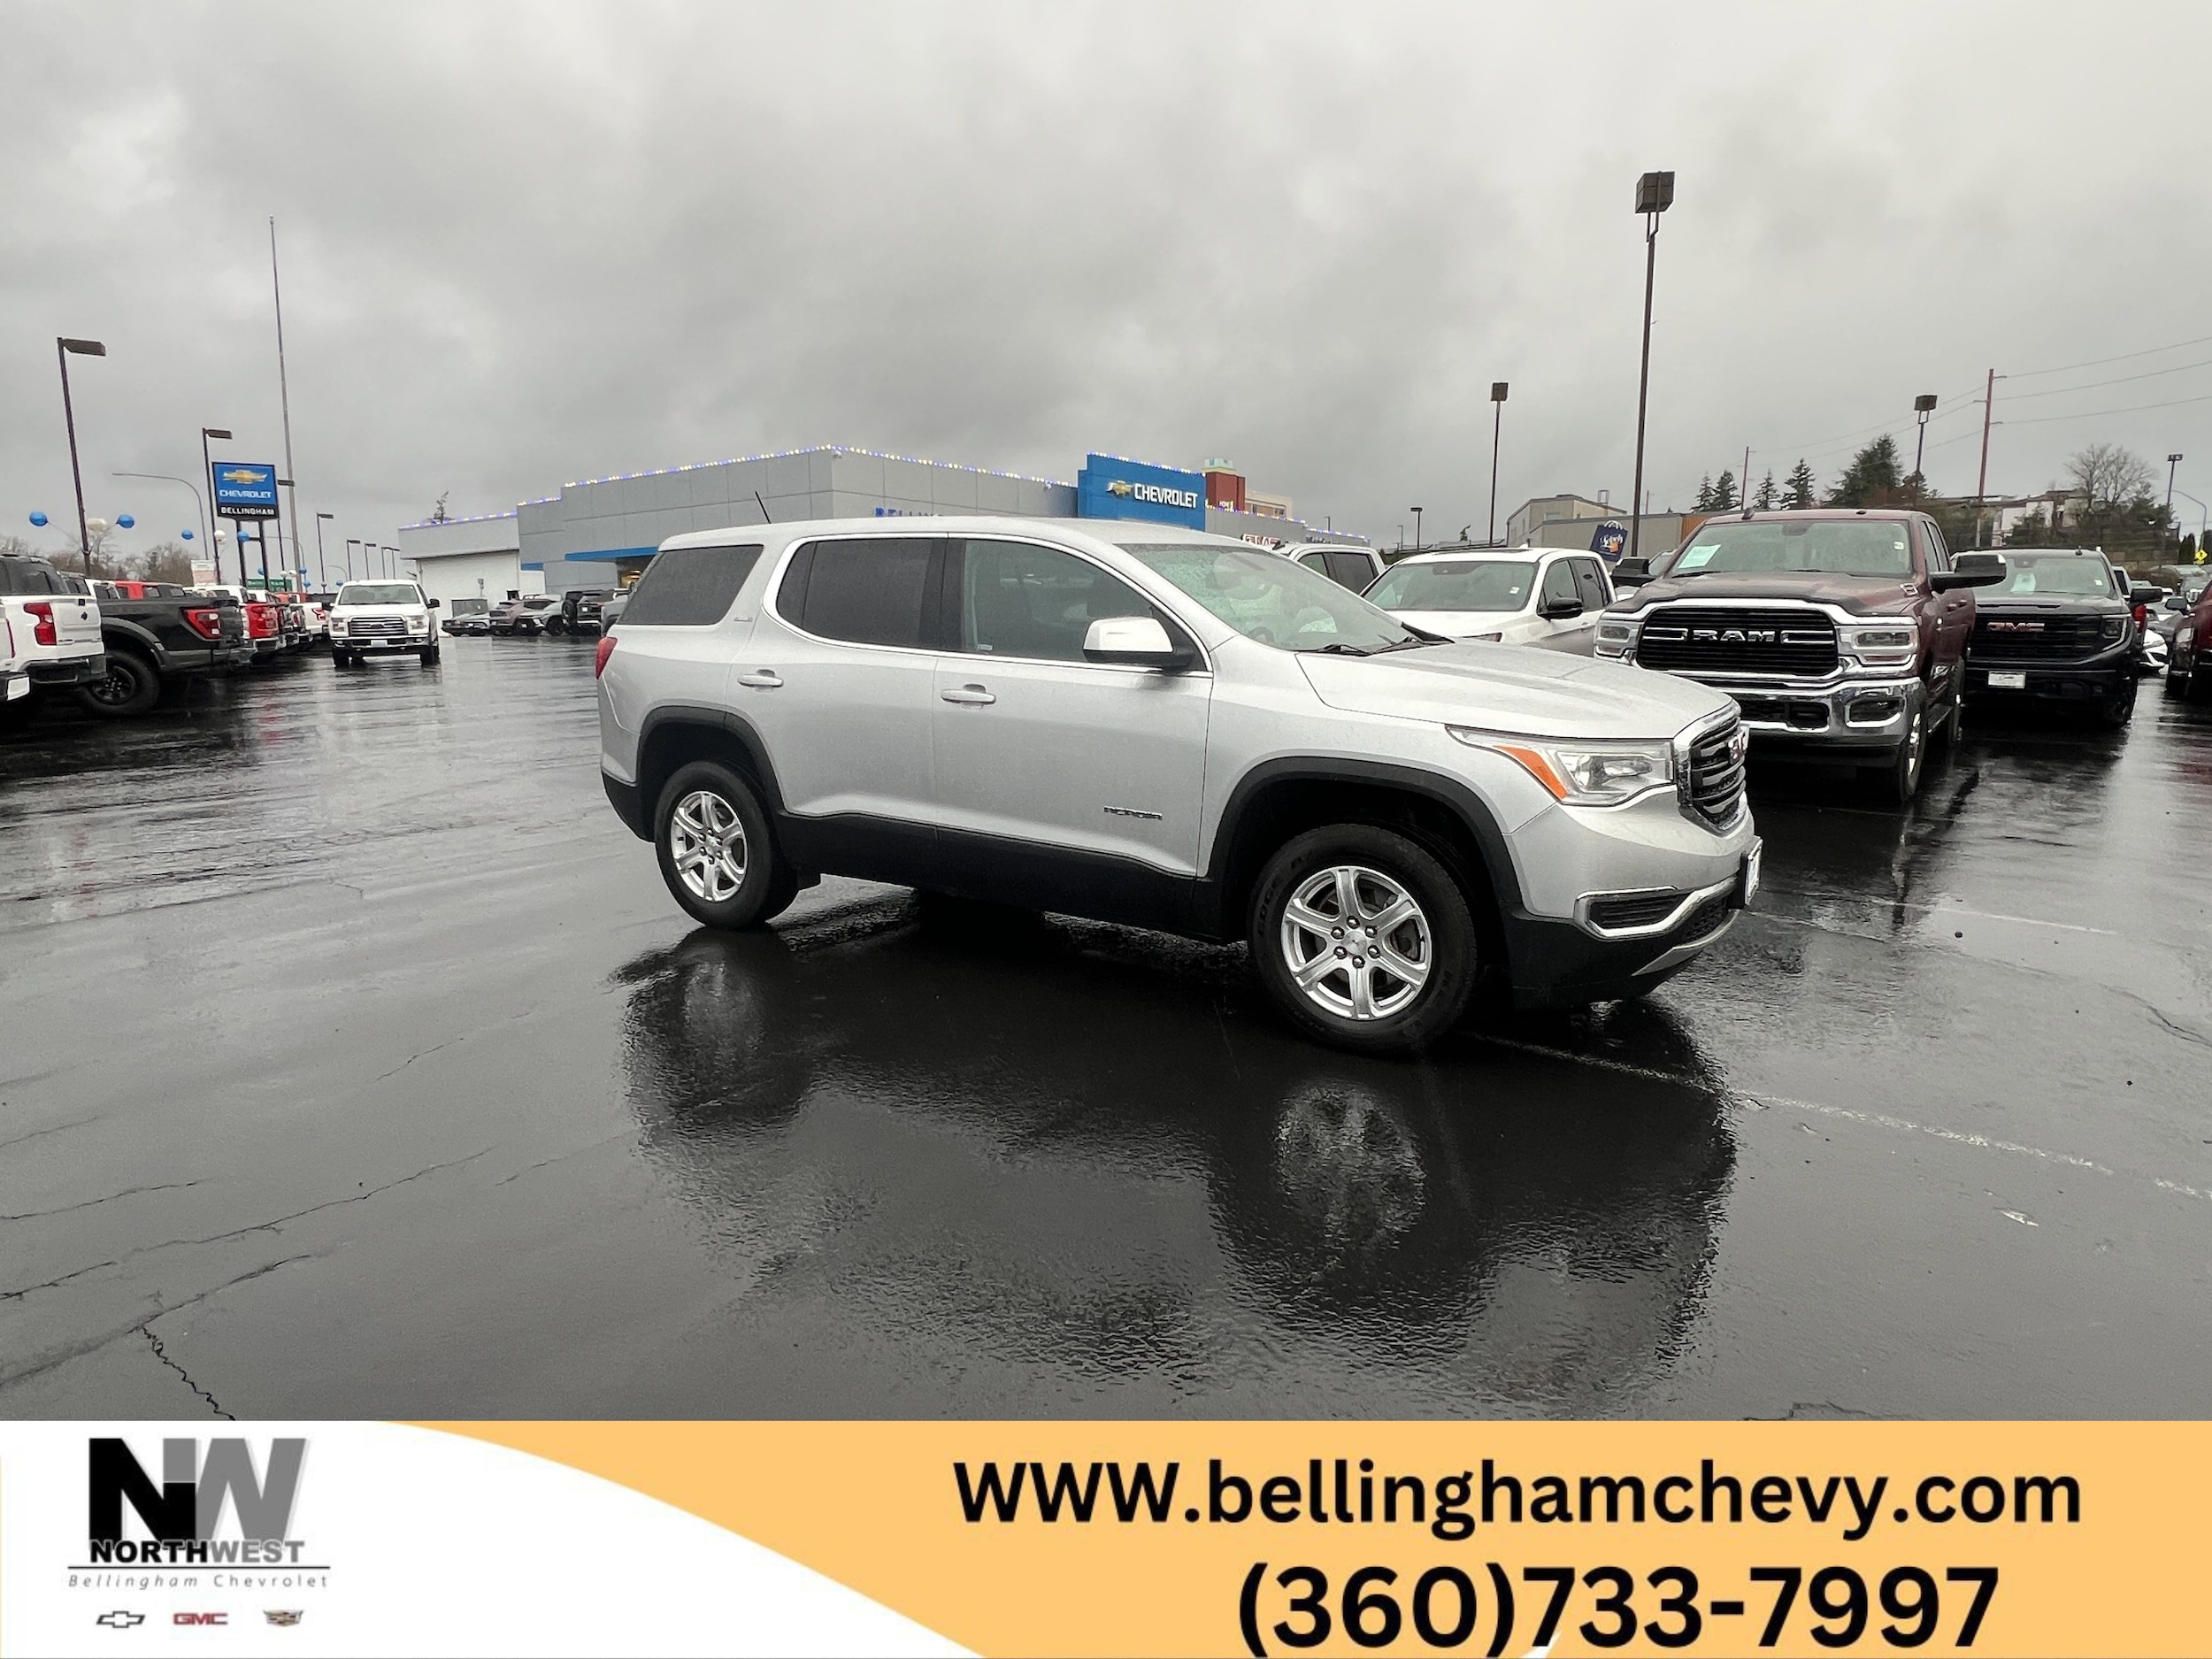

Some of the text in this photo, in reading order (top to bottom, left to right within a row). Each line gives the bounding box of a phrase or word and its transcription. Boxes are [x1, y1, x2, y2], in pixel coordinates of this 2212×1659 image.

[219, 489, 272, 498] CHEVROLET
[1134, 483, 1198, 509] CHEVROLET
[1693, 629, 1776, 642] RAM
